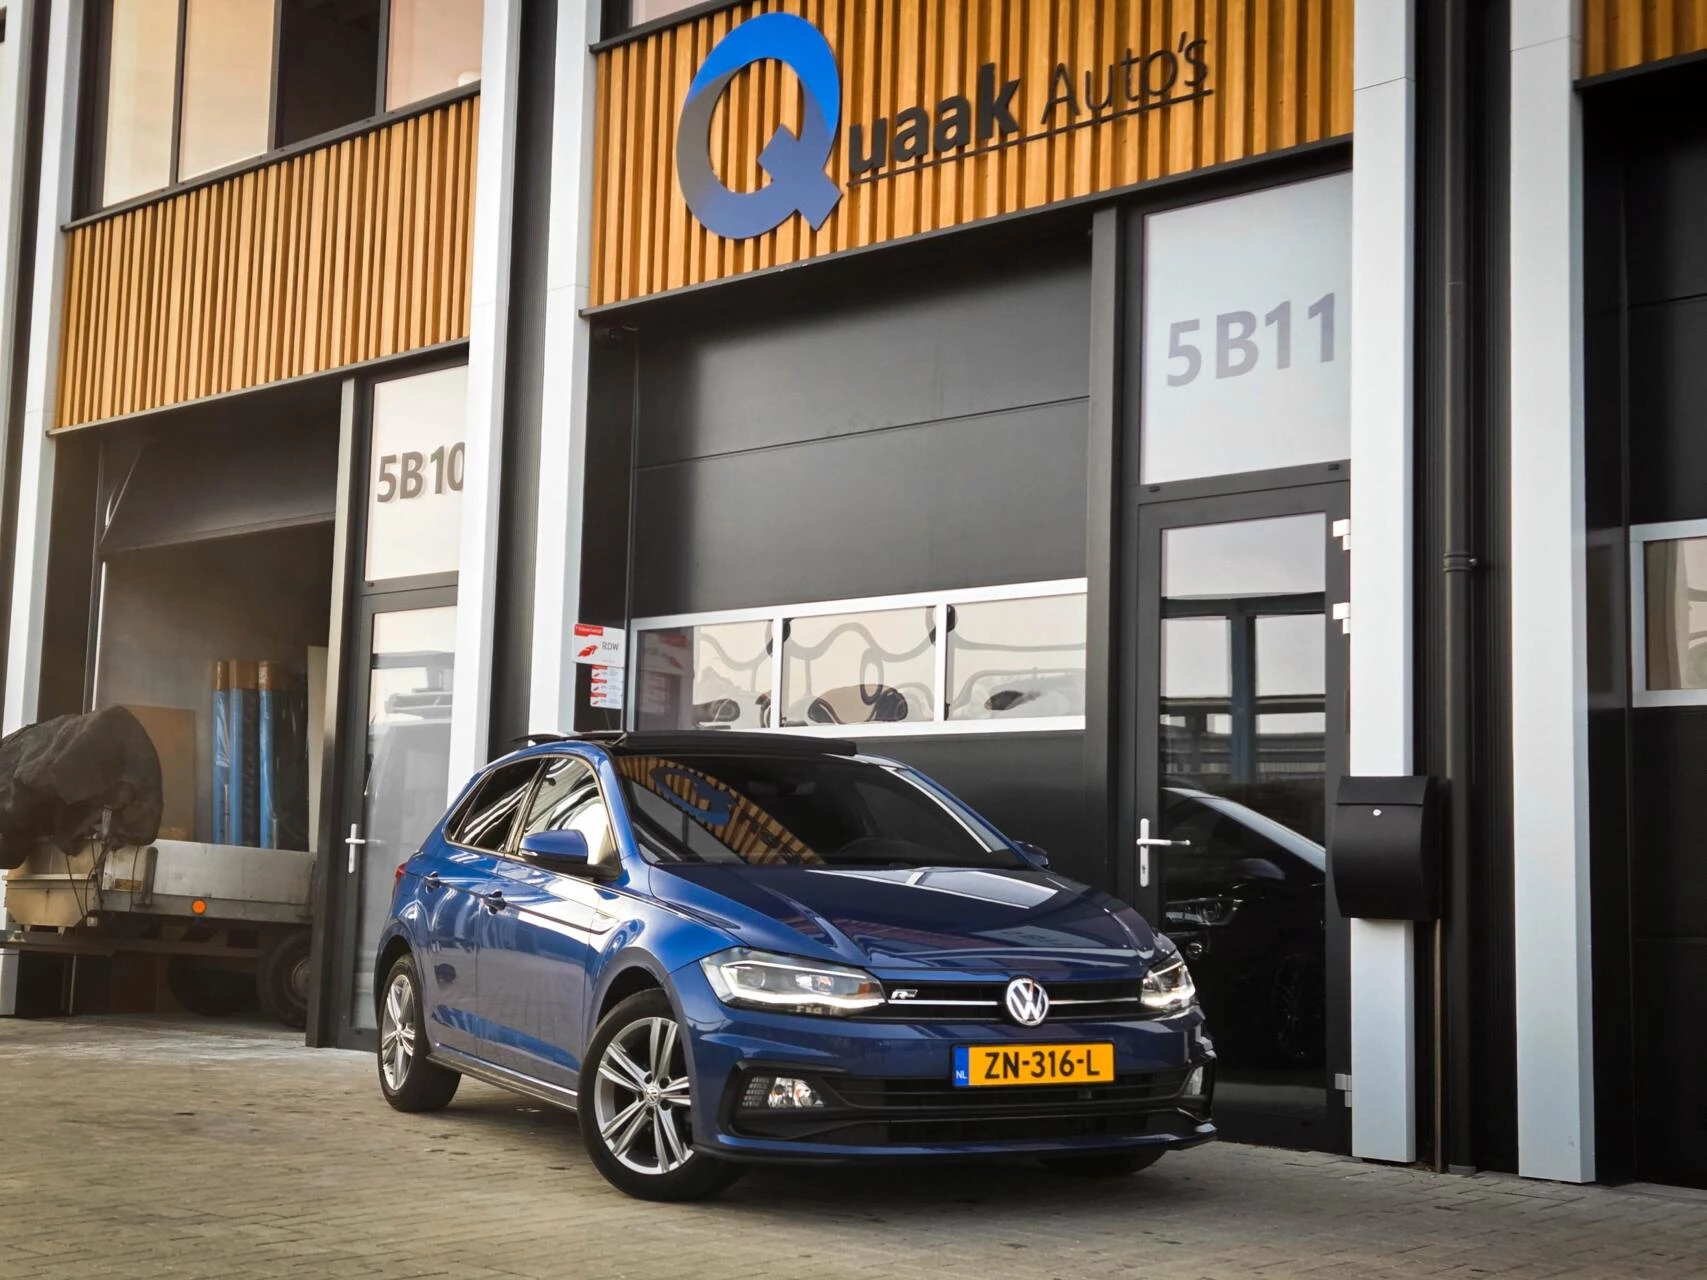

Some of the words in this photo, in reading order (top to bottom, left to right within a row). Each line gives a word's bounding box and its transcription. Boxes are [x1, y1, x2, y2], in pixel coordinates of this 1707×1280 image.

[676, 12, 1021, 240] Quaak
[1041, 31, 1208, 125] Auto's
[1167, 292, 1335, 387] 5B11
[376, 441, 466, 503] 5B10
[602, 641, 619, 651] RDW
[955, 1070, 968, 1080] NL
[984, 1049, 1100, 1080] ZN-316-L
